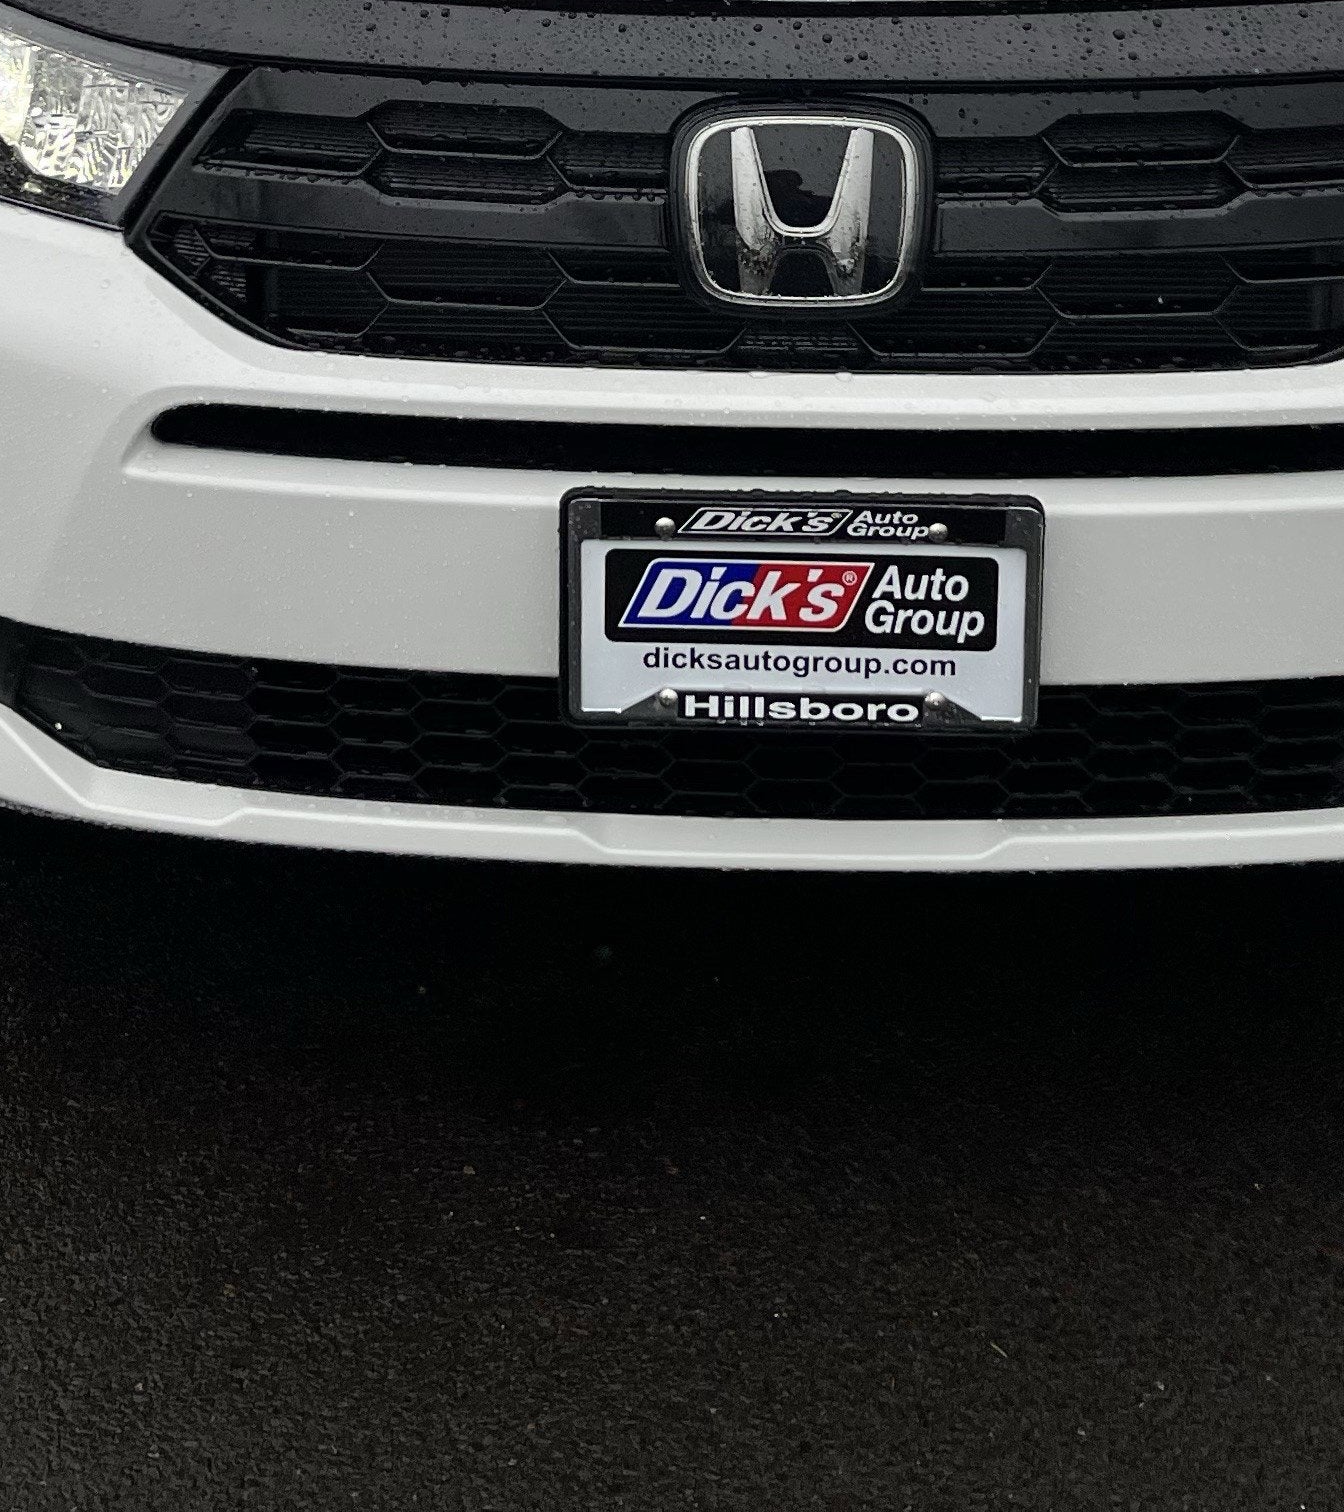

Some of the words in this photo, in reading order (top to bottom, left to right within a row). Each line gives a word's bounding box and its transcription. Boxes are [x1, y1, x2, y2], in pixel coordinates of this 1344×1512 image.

[847, 522, 931, 540] Group
[854, 510, 919, 525] Auto
[872, 565, 970, 602] Auto
[864, 600, 985, 643] Group
[643, 646, 957, 678] dicksautogroup.com
[683, 694, 920, 723] Hillsboro
